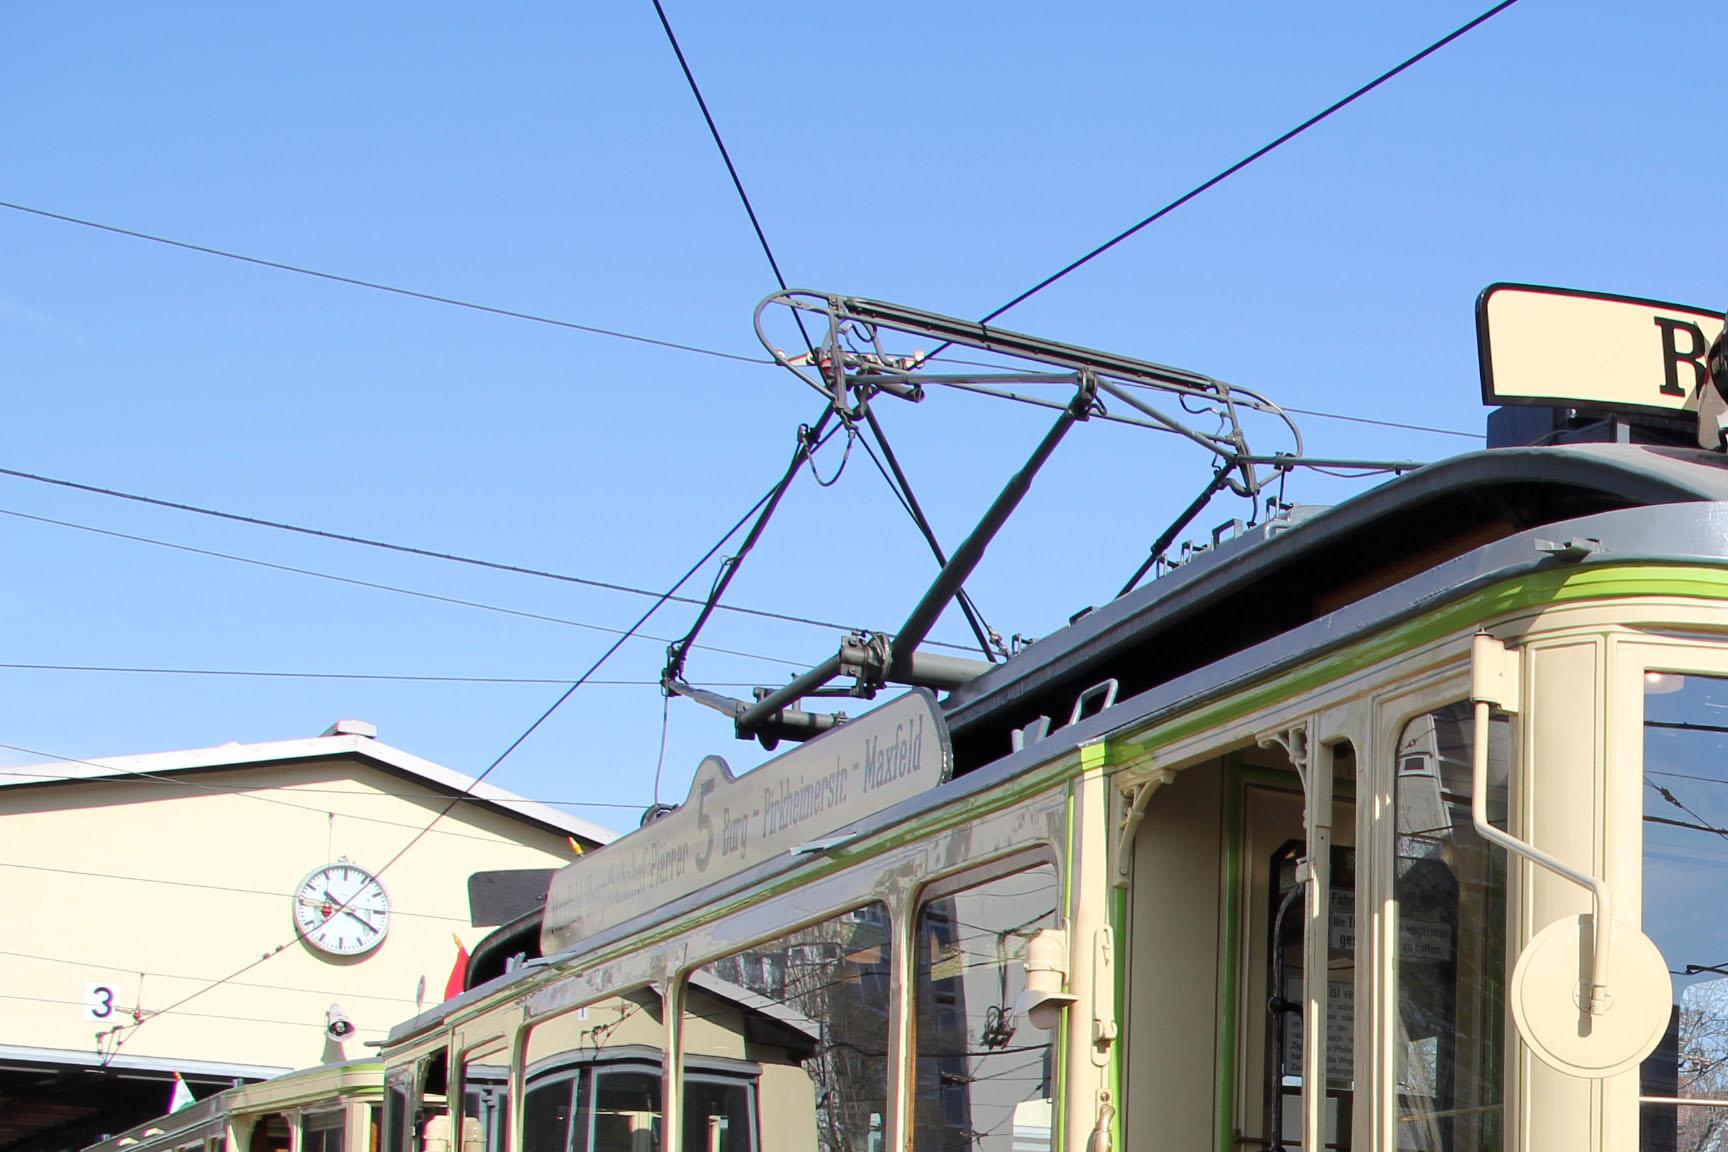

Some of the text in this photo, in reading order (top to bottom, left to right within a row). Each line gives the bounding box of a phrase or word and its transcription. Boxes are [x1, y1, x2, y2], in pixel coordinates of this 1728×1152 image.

[695, 777, 716, 873] 5
[721, 807, 749, 860] Burg
[763, 754, 848, 839] Pirkheimerstr.
[863, 713, 924, 794] Maxfeld
[92, 986, 113, 1017] 3
